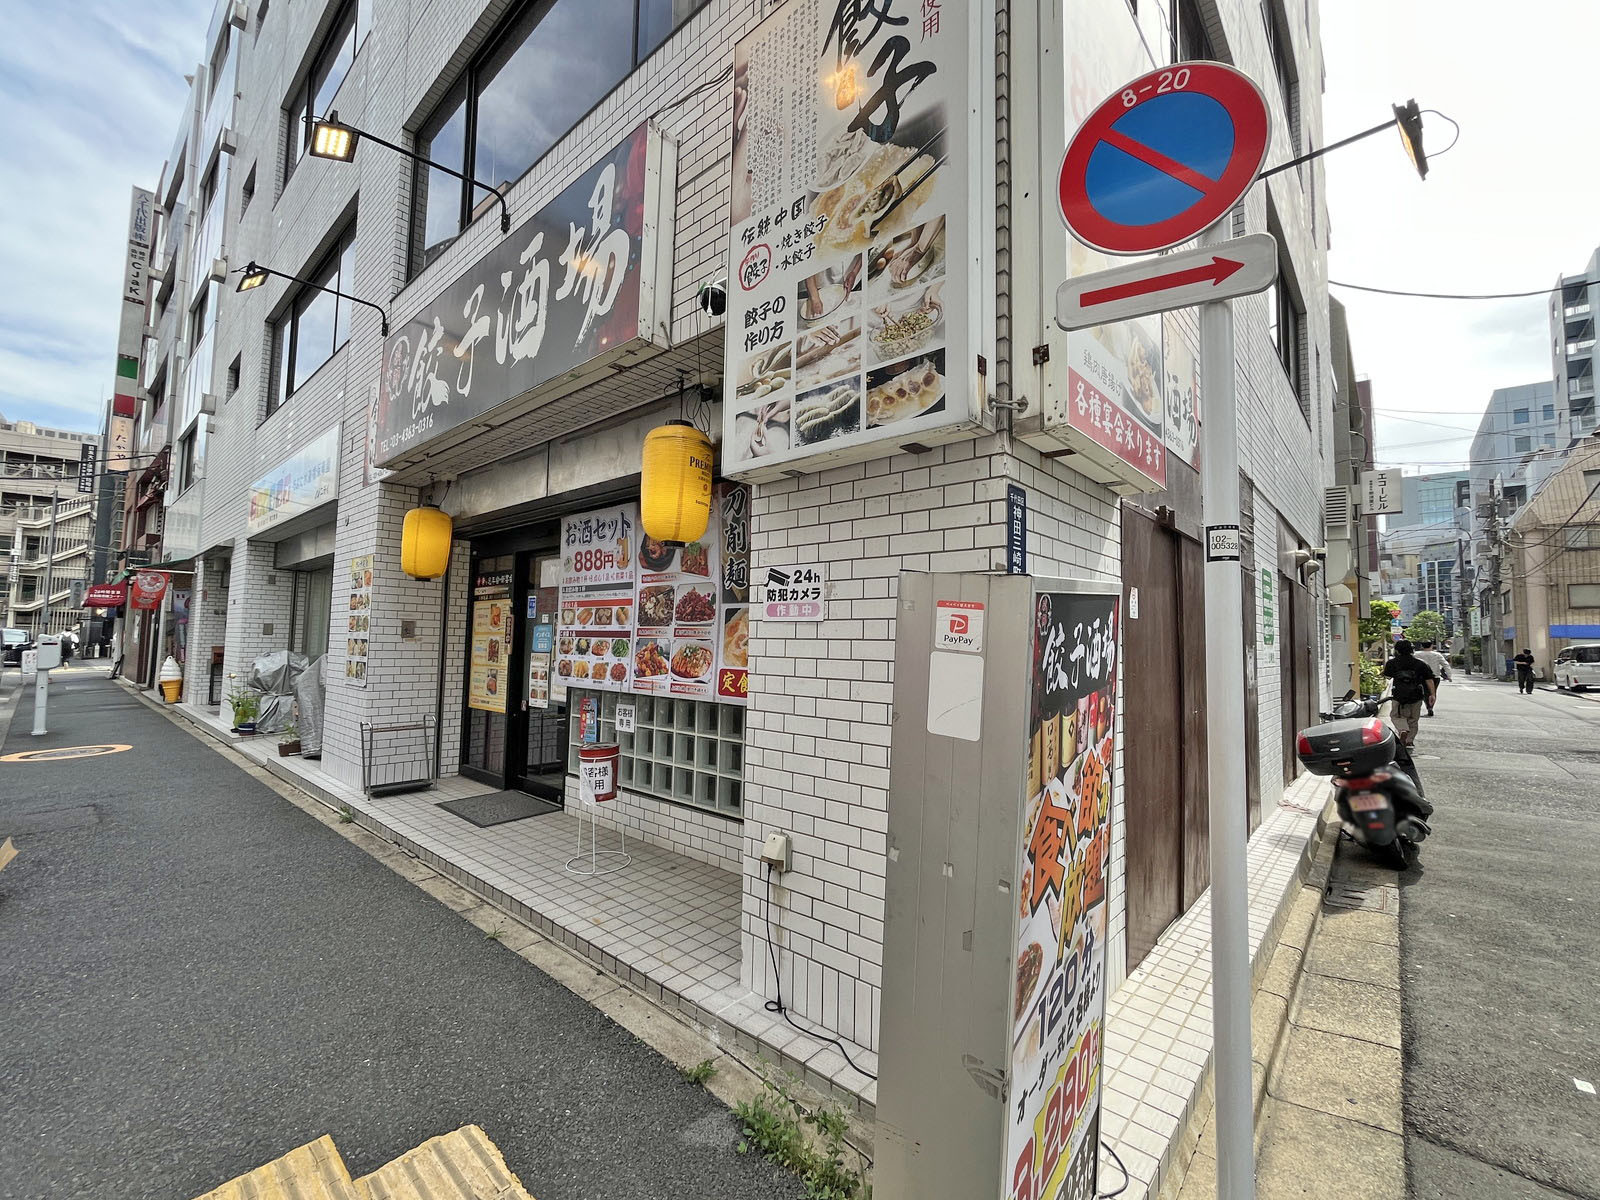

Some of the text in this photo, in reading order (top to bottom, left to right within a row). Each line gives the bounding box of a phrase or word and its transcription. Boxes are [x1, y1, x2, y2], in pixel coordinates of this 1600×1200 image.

[1121, 68, 1191, 108] 8-20
[741, 195, 806, 246] 伝統中国
[408, 163, 630, 419] 餃子酒場
[744, 296, 786, 329] 餃子の
[744, 320, 785, 352] 作り方
[1075, 380, 1161, 471] 各種宴会承ります
[1377, 473, 1389, 510] エコービル
[566, 511, 631, 546] お酒セット
[724, 488, 748, 590] 刀削麺
[574, 548, 614, 572] 888円
[794, 569, 820, 584] 24h
[767, 588, 820, 602] 防犯カメラ
[777, 604, 812, 617] 作動中
[944, 634, 973, 645] PayPay
[1042, 610, 1116, 694] 餃子酒場
[583, 766, 609, 778] 客様
